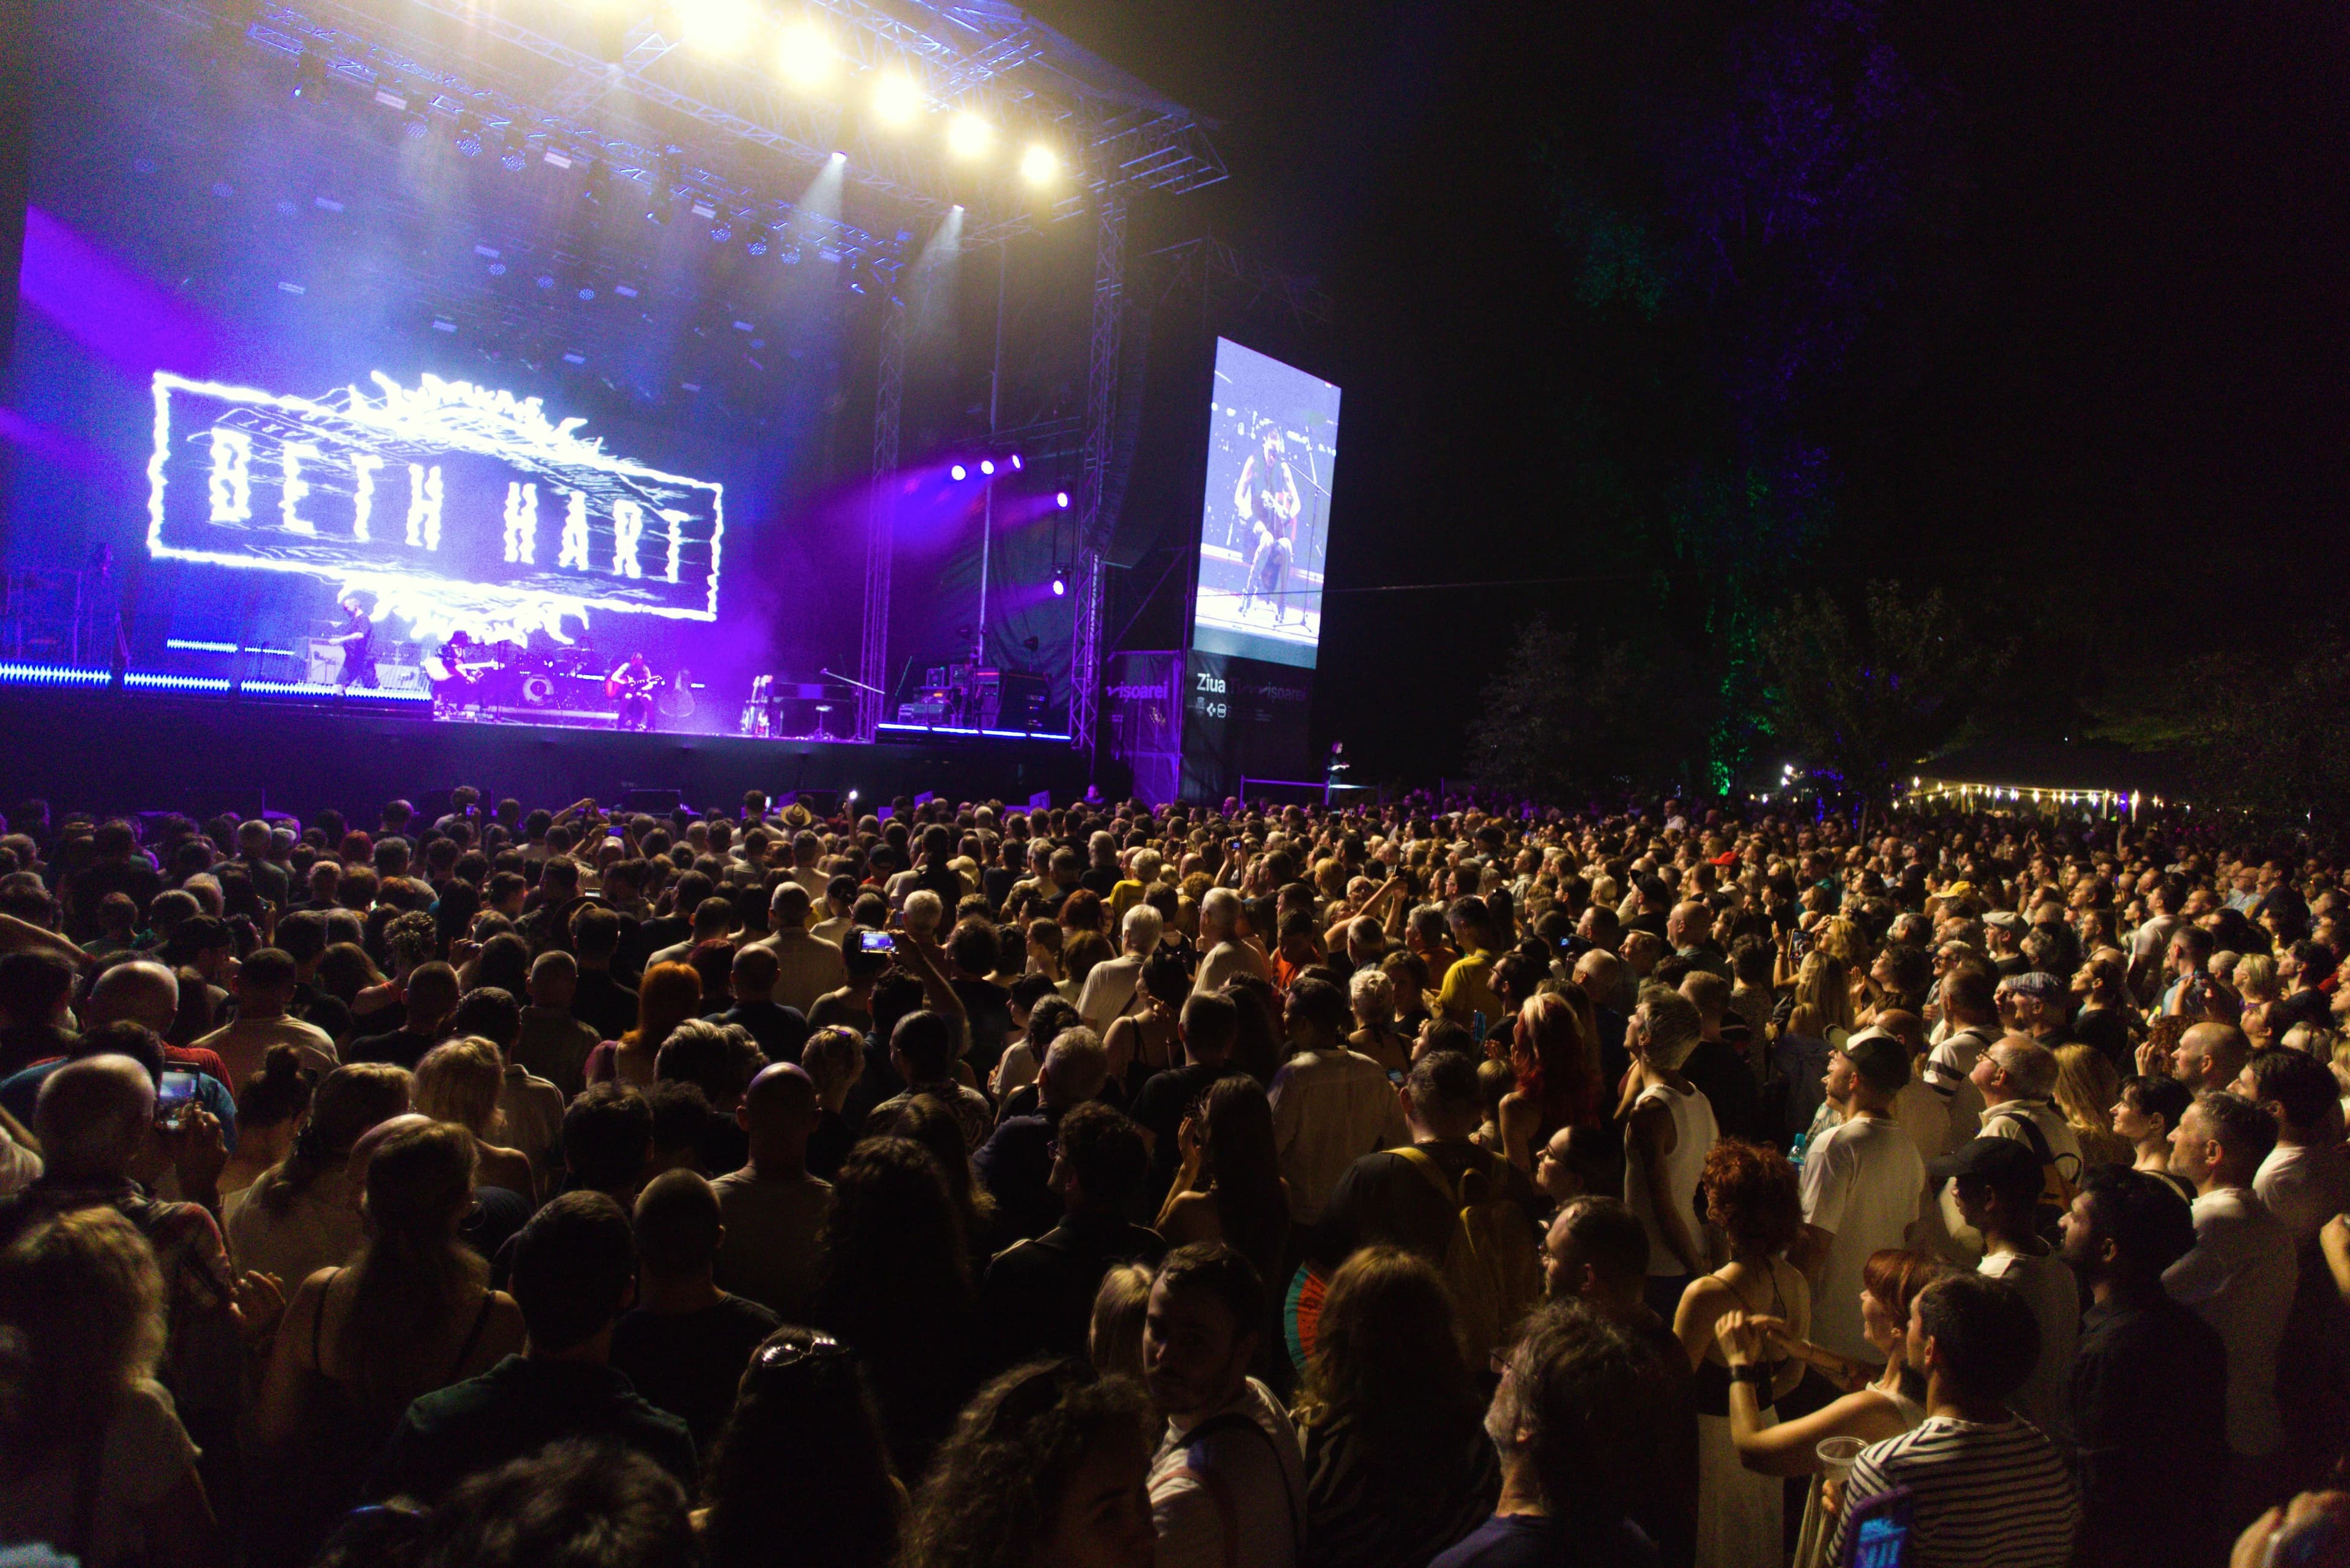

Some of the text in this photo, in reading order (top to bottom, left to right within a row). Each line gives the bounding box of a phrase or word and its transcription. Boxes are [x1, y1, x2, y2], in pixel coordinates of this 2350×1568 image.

[209, 428, 690, 583] BETH HART
[1196, 673, 1226, 693] Ziua
